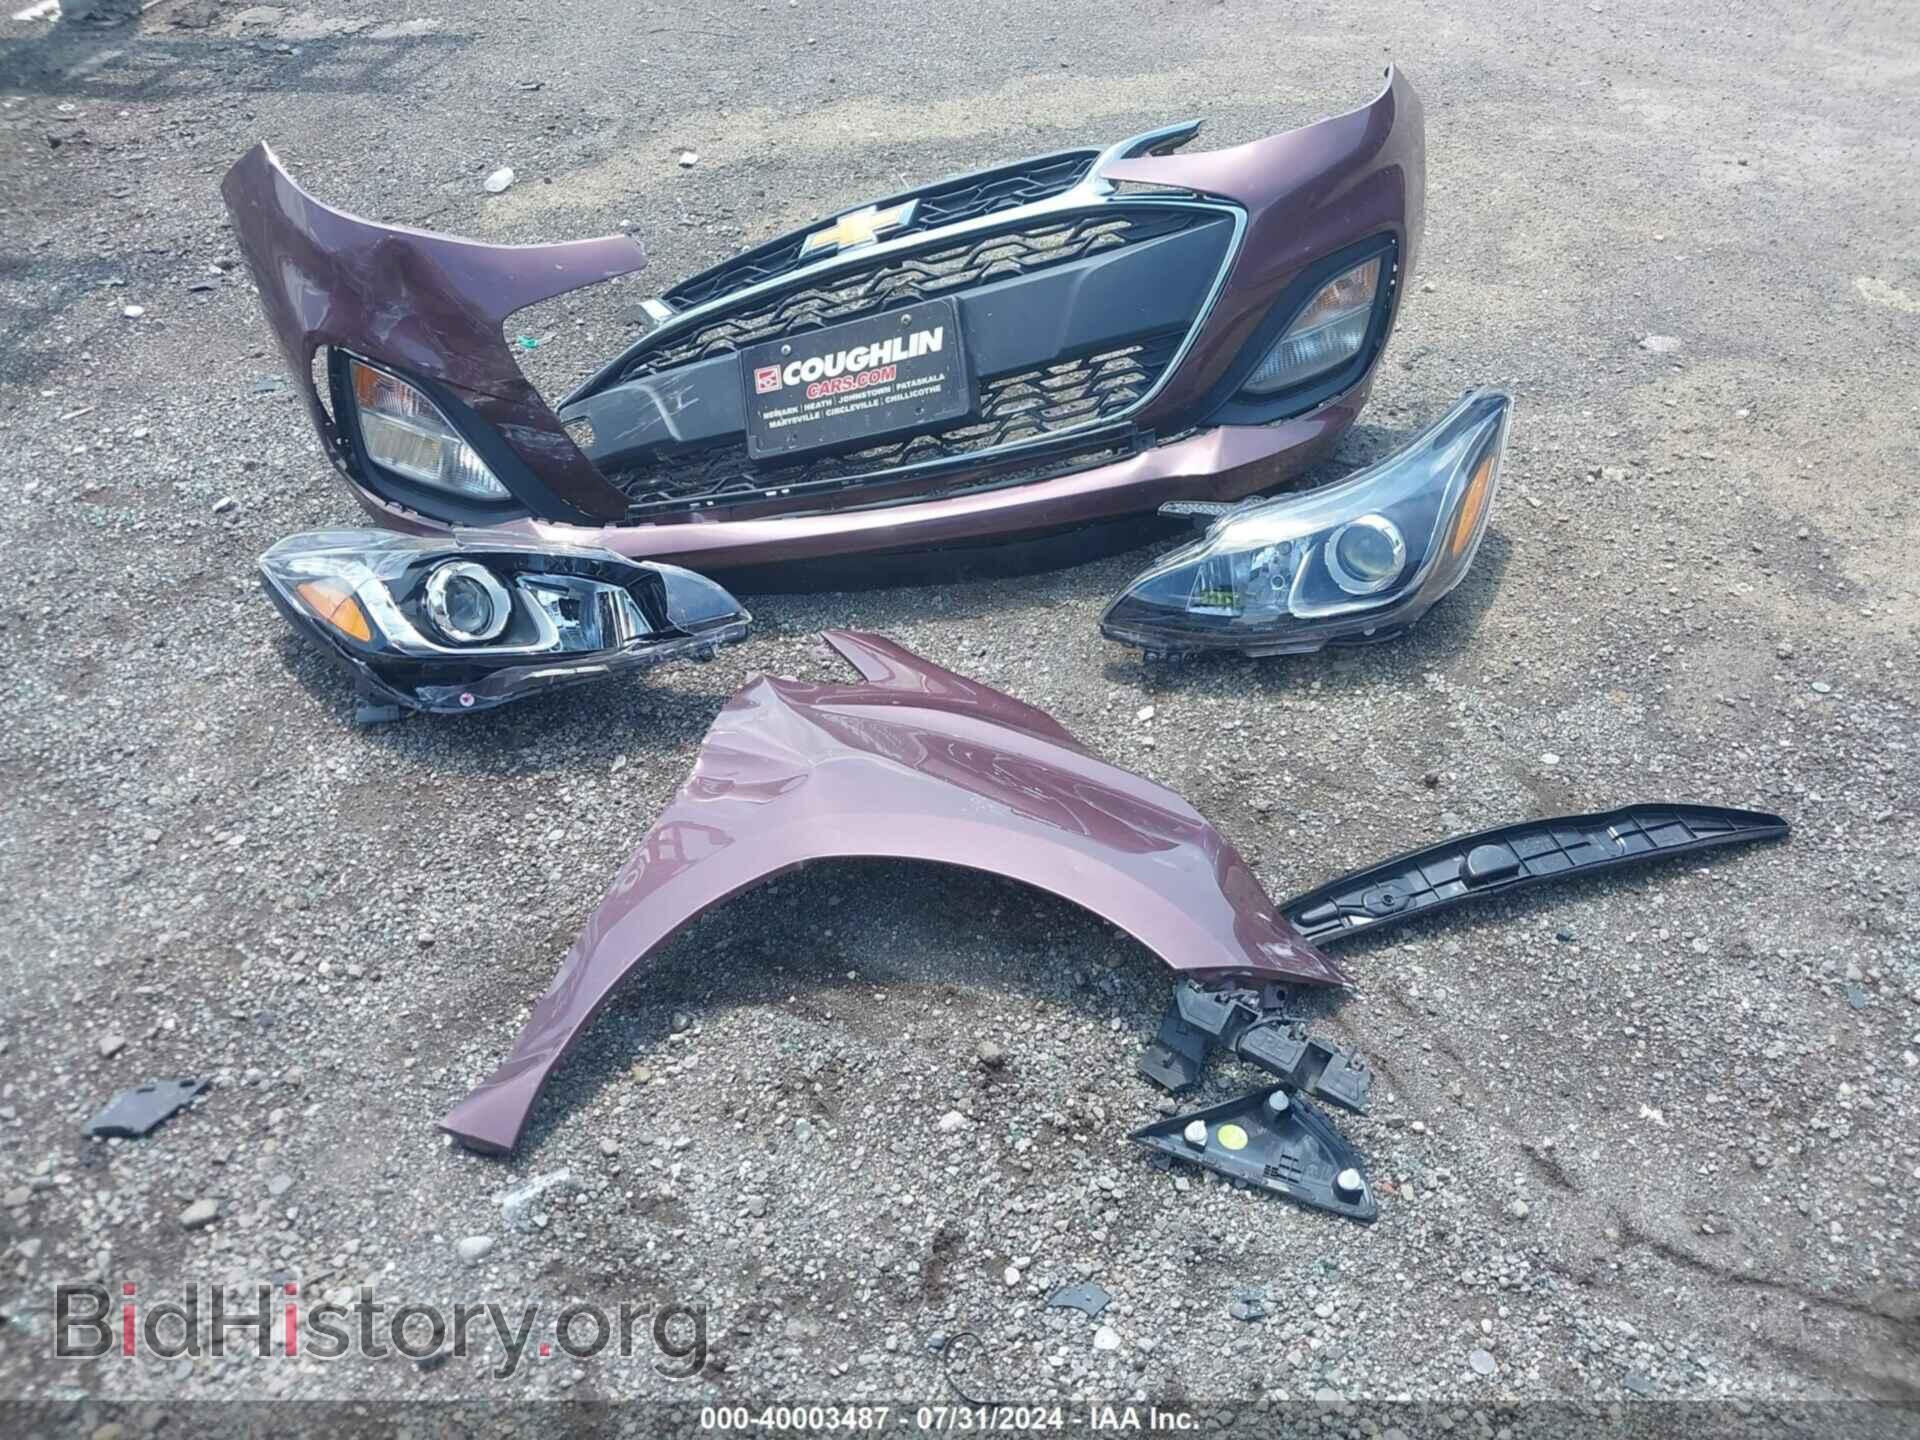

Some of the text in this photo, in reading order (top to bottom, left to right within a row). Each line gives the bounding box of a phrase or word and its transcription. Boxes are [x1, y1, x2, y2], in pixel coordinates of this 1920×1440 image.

[783, 327, 944, 386] COUGHLIN
[804, 398, 833, 412] HEATH
[838, 385, 891, 404] JOHNSTOWN
[896, 373, 945, 391] PATASKALA
[806, 364, 897, 399] CARS.COM
[768, 384, 942, 429] MARYSVILLE CIRCLEVILLE CHILLICOTHE
